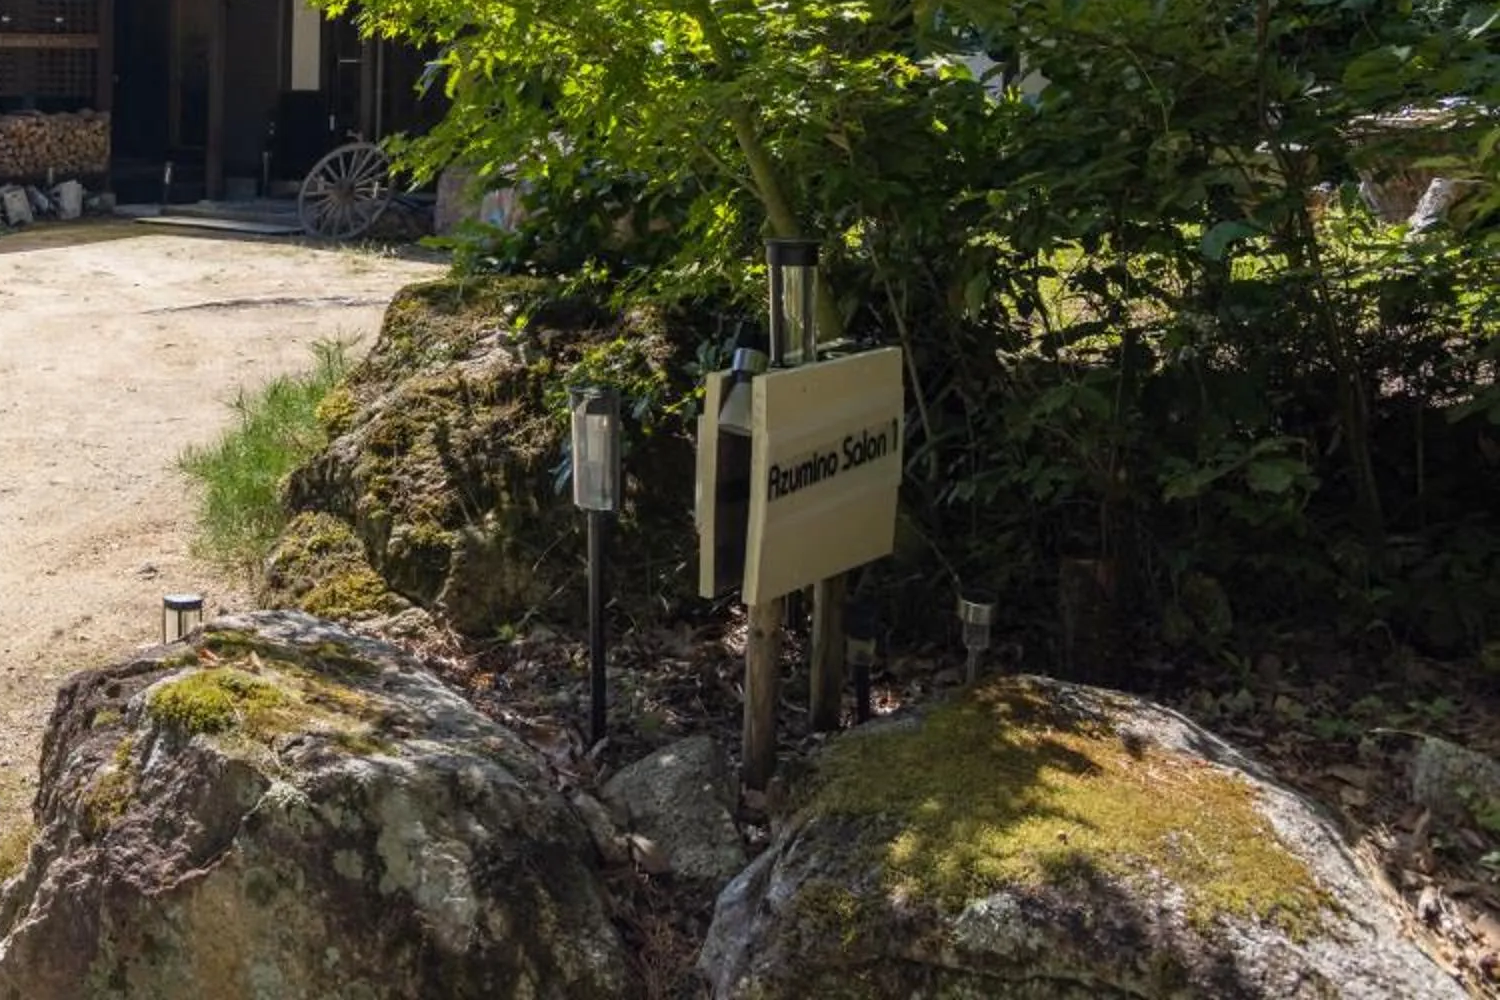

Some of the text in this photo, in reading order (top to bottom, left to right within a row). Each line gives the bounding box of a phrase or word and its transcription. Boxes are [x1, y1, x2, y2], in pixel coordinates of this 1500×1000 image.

[767, 417, 898, 502] Azumino Salon 1
